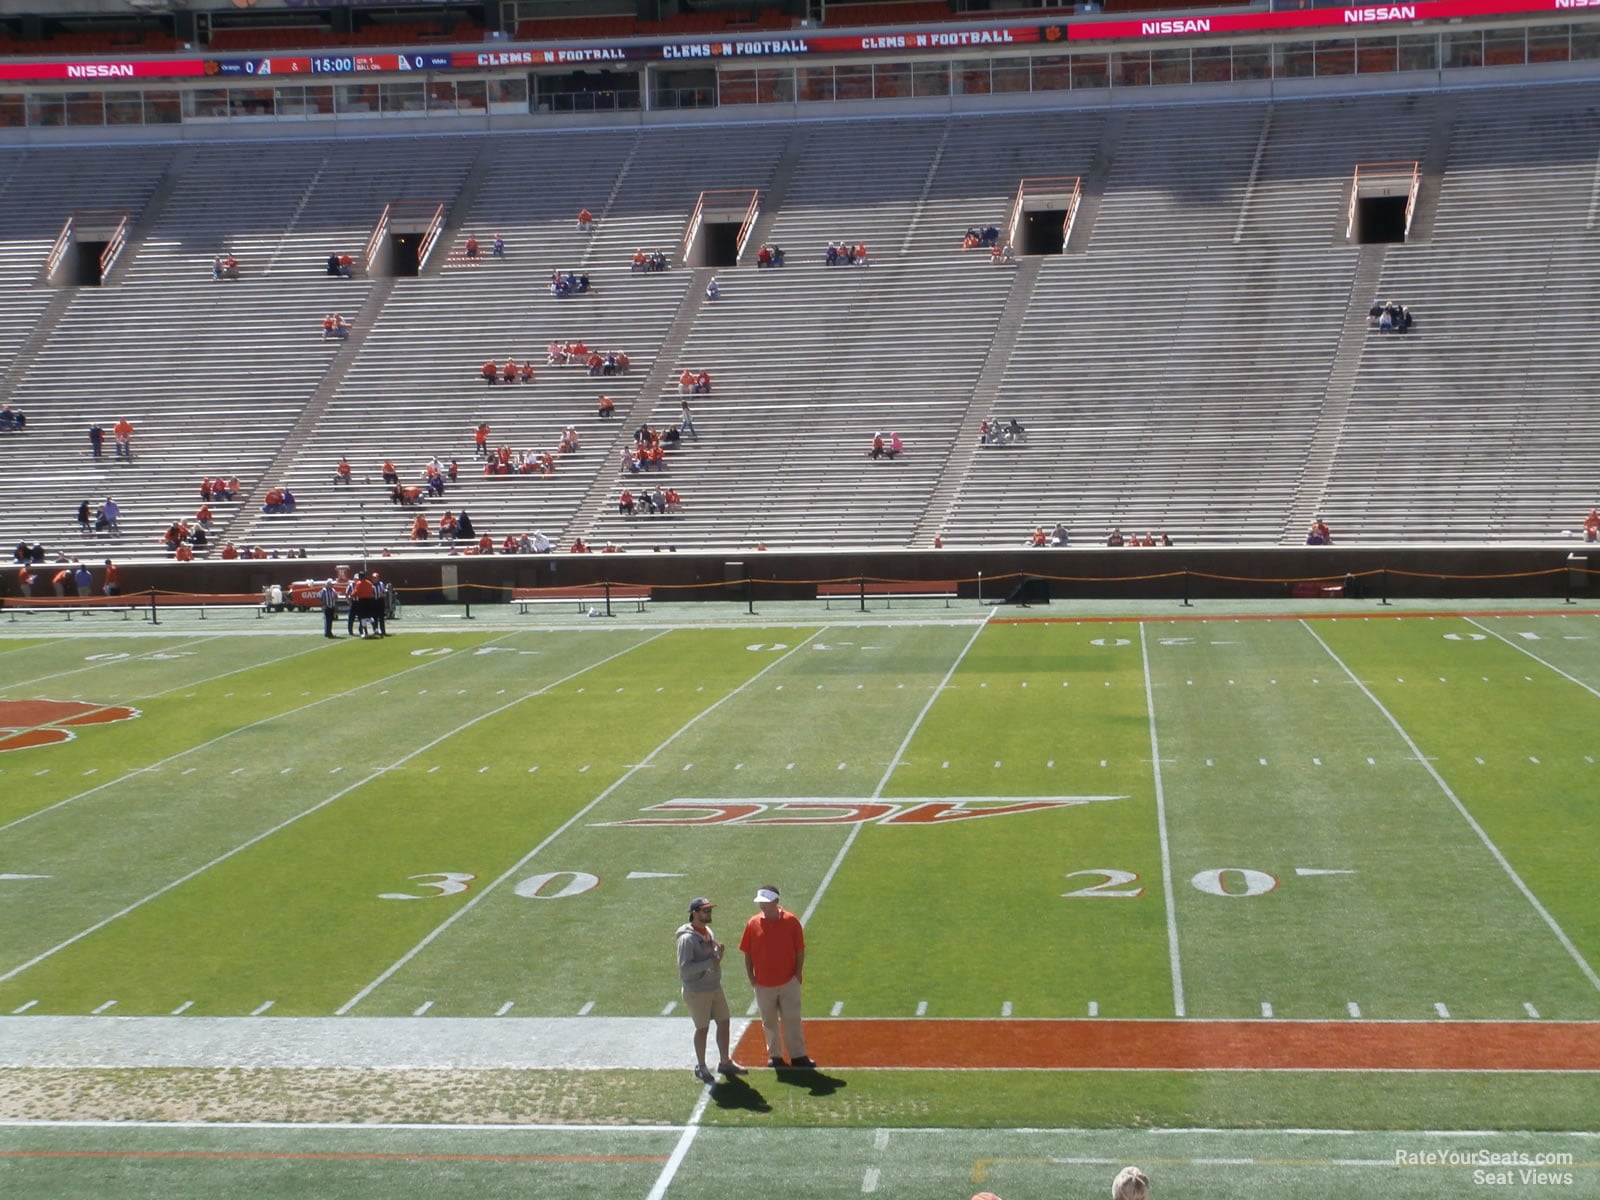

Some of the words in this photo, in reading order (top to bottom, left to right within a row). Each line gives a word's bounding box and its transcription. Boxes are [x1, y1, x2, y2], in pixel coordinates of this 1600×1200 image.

[1344, 6, 1415, 23] NISSAN
[1142, 19, 1210, 34] NISSAN
[931, 29, 1013, 46] FOOTBALL
[736, 39, 808, 55] FOOTBALL
[415, 56, 424, 68] 0
[558, 48, 626, 62] FOOTBALL
[67, 64, 134, 77] NISSAN
[245, 61, 254, 74] 0
[314, 58, 351, 71] 15:00
[1060, 867, 1281, 898] 20
